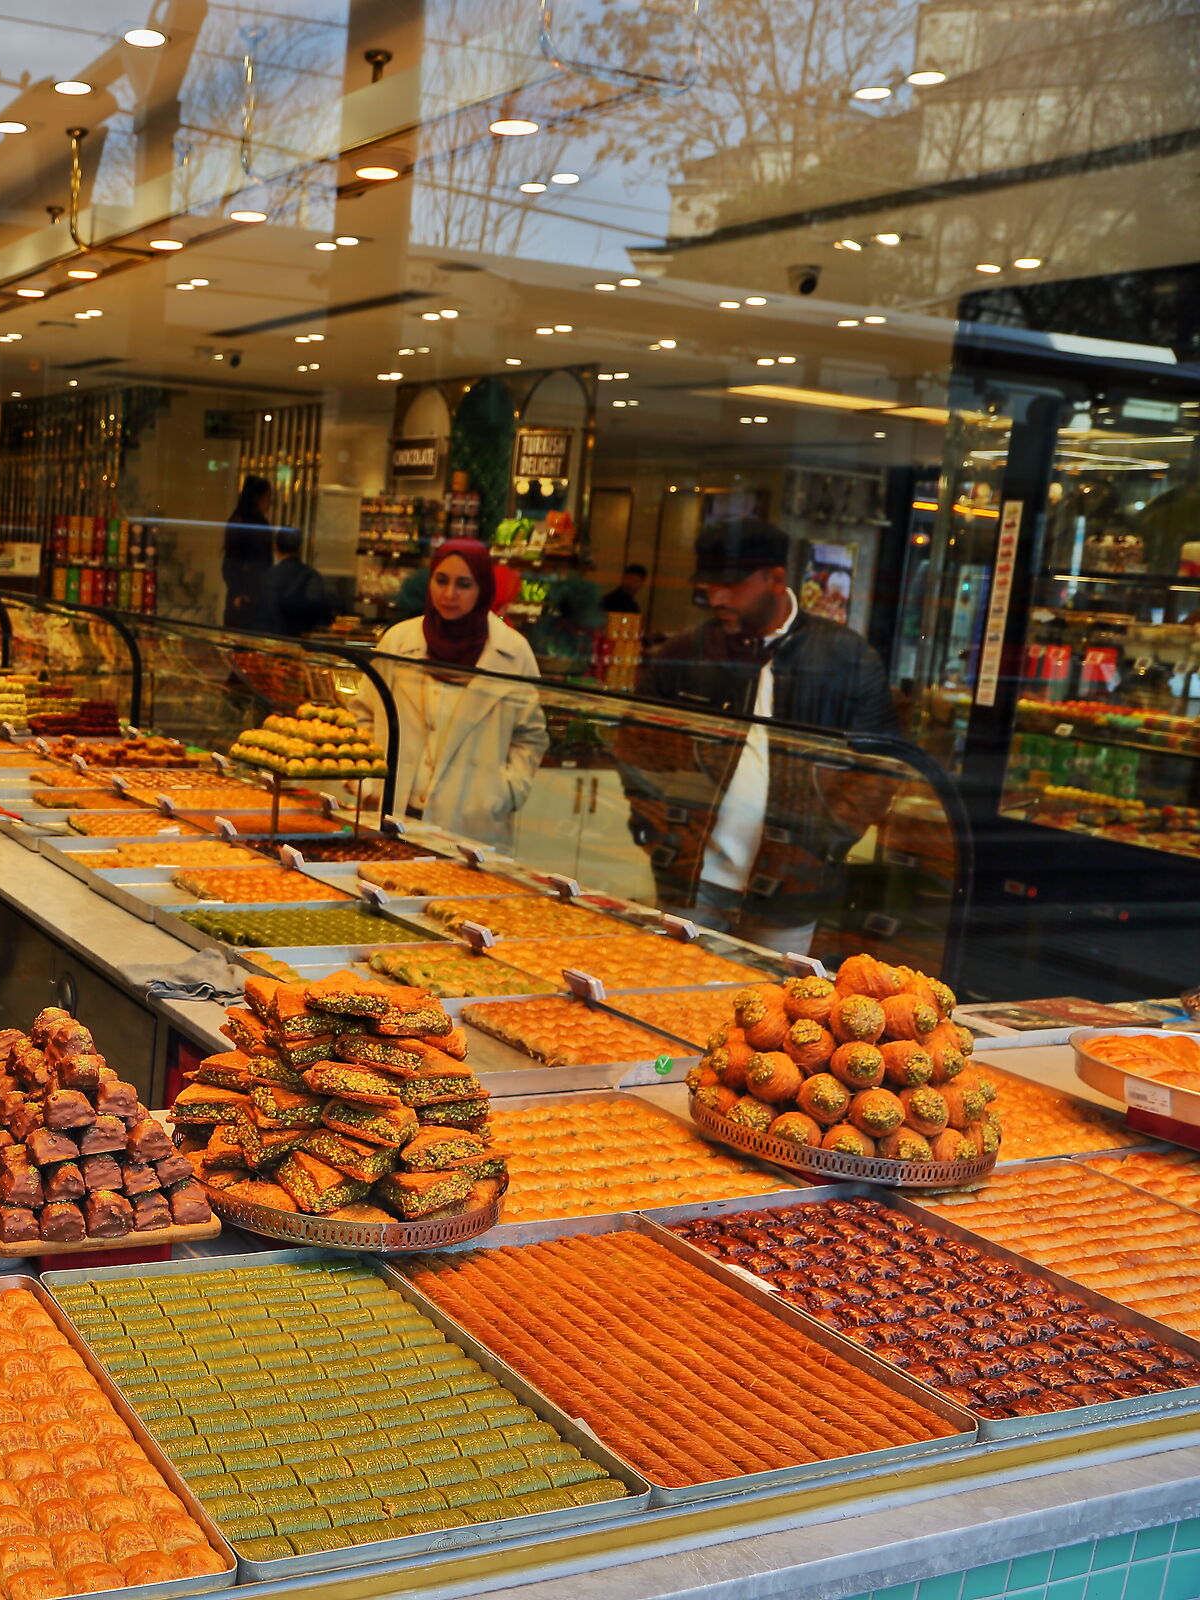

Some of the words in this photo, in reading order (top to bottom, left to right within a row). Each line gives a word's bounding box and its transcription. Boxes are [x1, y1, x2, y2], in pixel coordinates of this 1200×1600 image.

[521, 436, 567, 455] TURKISH
[393, 448, 436, 466] CHOCOLATE
[519, 455, 563, 475] DELIGHT
